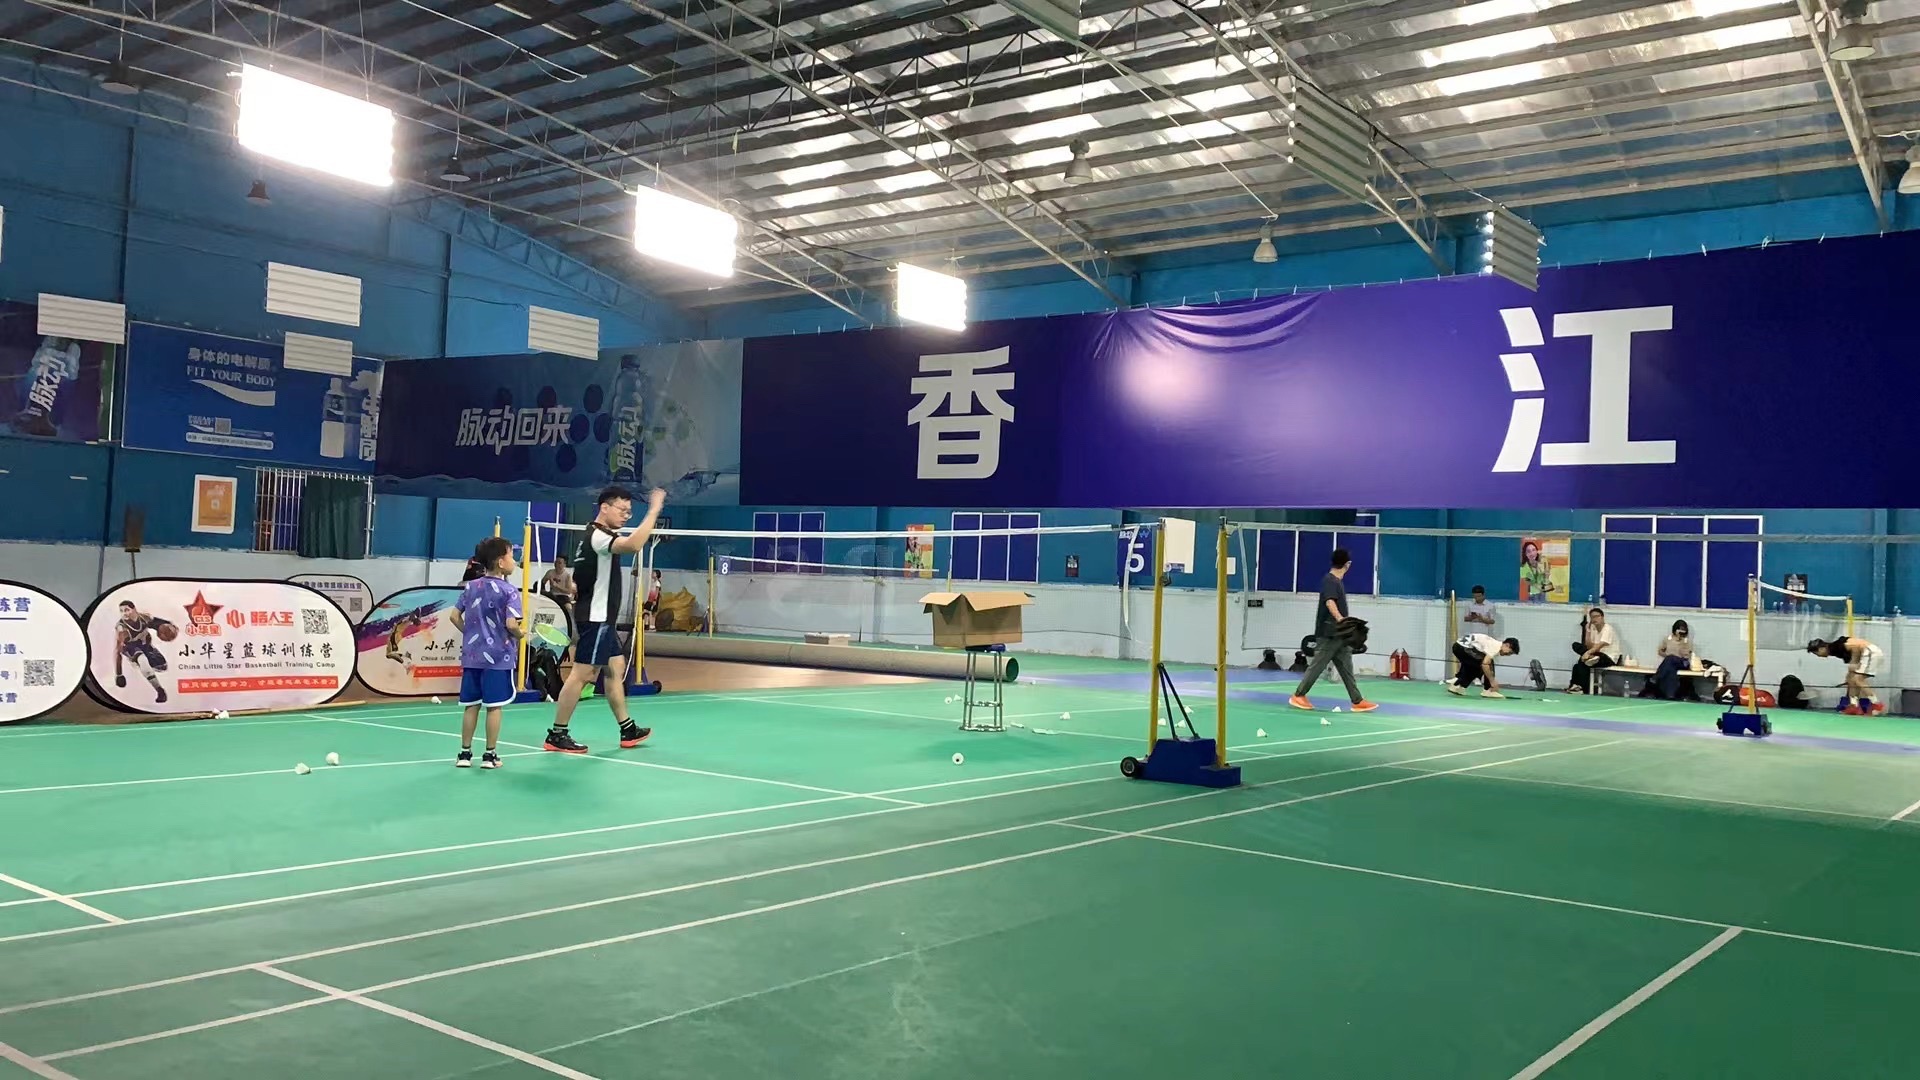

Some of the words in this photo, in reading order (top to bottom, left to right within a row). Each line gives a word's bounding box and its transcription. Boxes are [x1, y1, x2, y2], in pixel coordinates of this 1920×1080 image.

[186, 364, 206, 377] FIT
[211, 368, 242, 382] YOUR
[245, 373, 276, 387] BODY
[907, 345, 1015, 480] 香
[1491, 305, 1677, 474] 江
[455, 405, 573, 455] 脉动回来
[1128, 543, 1144, 572] 5
[721, 562, 729, 575] 8
[178, 642, 334, 660] 小华星篮球训练营
[424, 639, 463, 653] 小华
[178, 663, 201, 671] China
[244, 661, 283, 669] Basketball
[285, 661, 314, 669] Training
[316, 661, 336, 669] Camp
